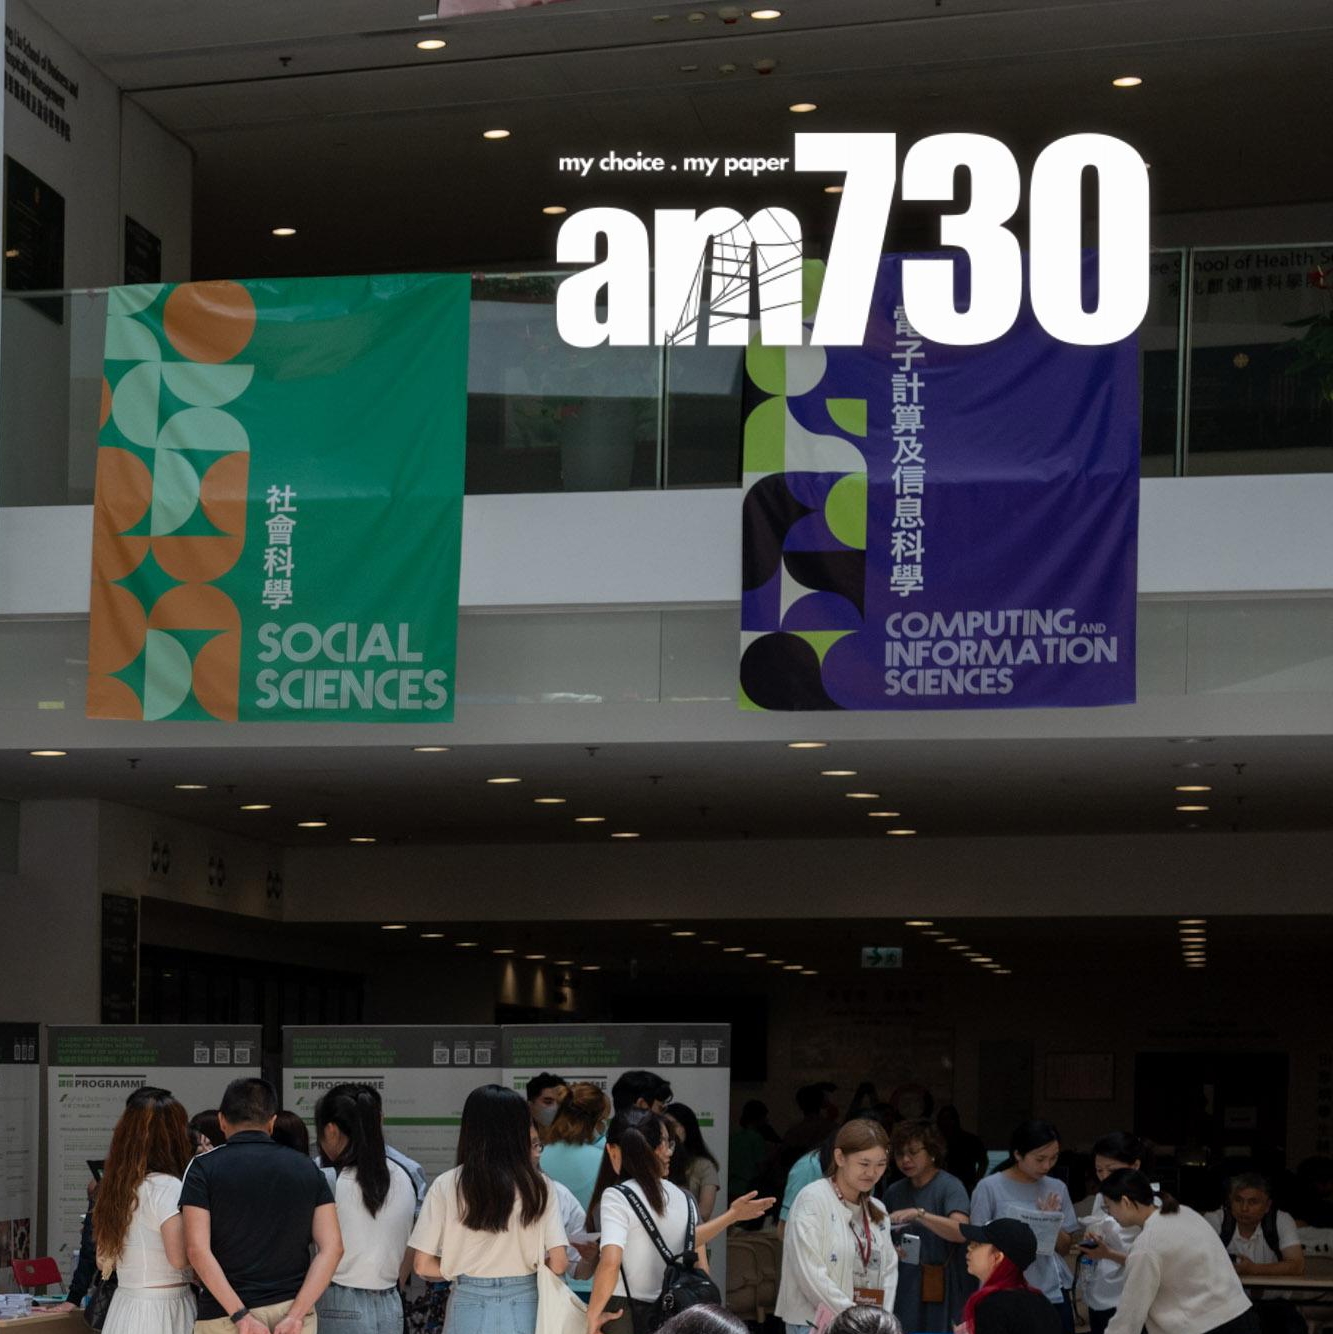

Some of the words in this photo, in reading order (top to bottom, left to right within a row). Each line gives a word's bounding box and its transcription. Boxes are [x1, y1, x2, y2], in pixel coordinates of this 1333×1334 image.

[1174, 257, 1229, 274] Shool
[261, 484, 298, 610] 社會科學
[886, 608, 1076, 639] COMPUTING
[1080, 623, 1107, 635] AND
[257, 621, 424, 663] SOCIAL
[884, 636, 1118, 668] INFORMATION
[255, 668, 448, 711] SCIENCES
[884, 667, 1014, 697] SCIENCES
[75, 1080, 147, 1089] PROGRAMME
